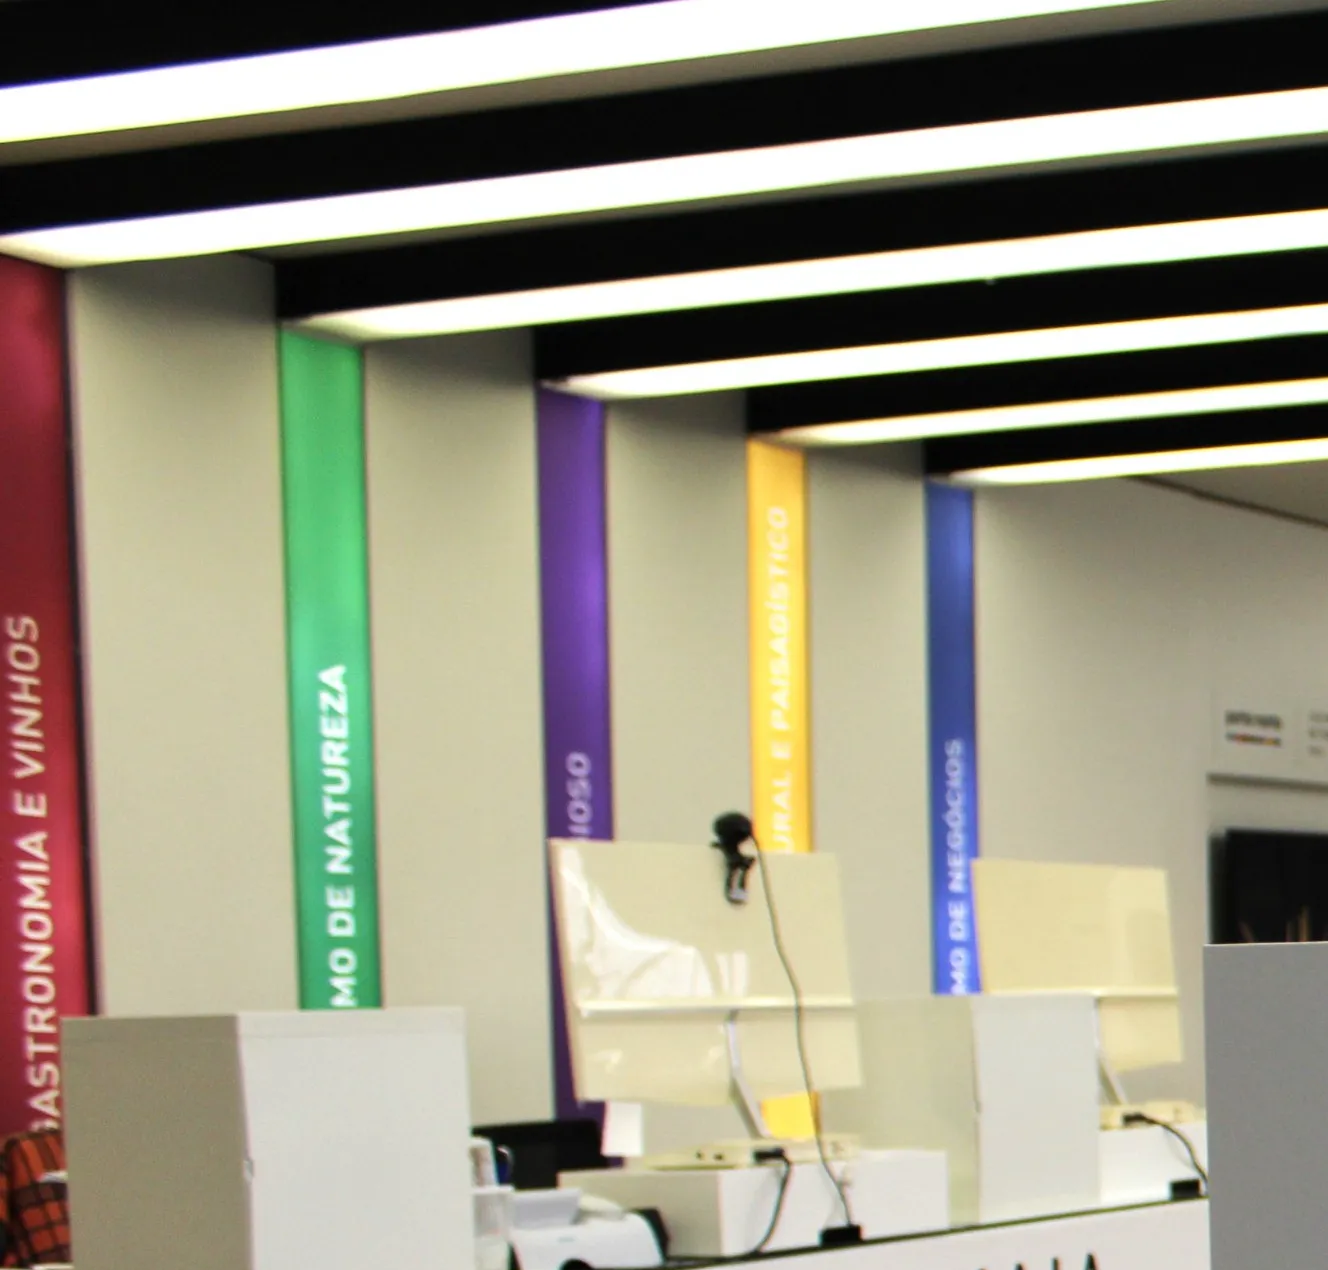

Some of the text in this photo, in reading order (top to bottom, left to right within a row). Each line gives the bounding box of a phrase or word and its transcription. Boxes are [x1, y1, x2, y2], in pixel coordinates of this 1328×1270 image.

[5, 614, 46, 781] VINHOS
[770, 739, 792, 761] E
[13, 791, 48, 819] E
[565, 751, 594, 836] IOSO
[771, 769, 795, 854] URAL
[317, 664, 359, 1007] MO DE NATUREZA
[947, 900, 969, 942] DE
[949, 946, 970, 996] MO
